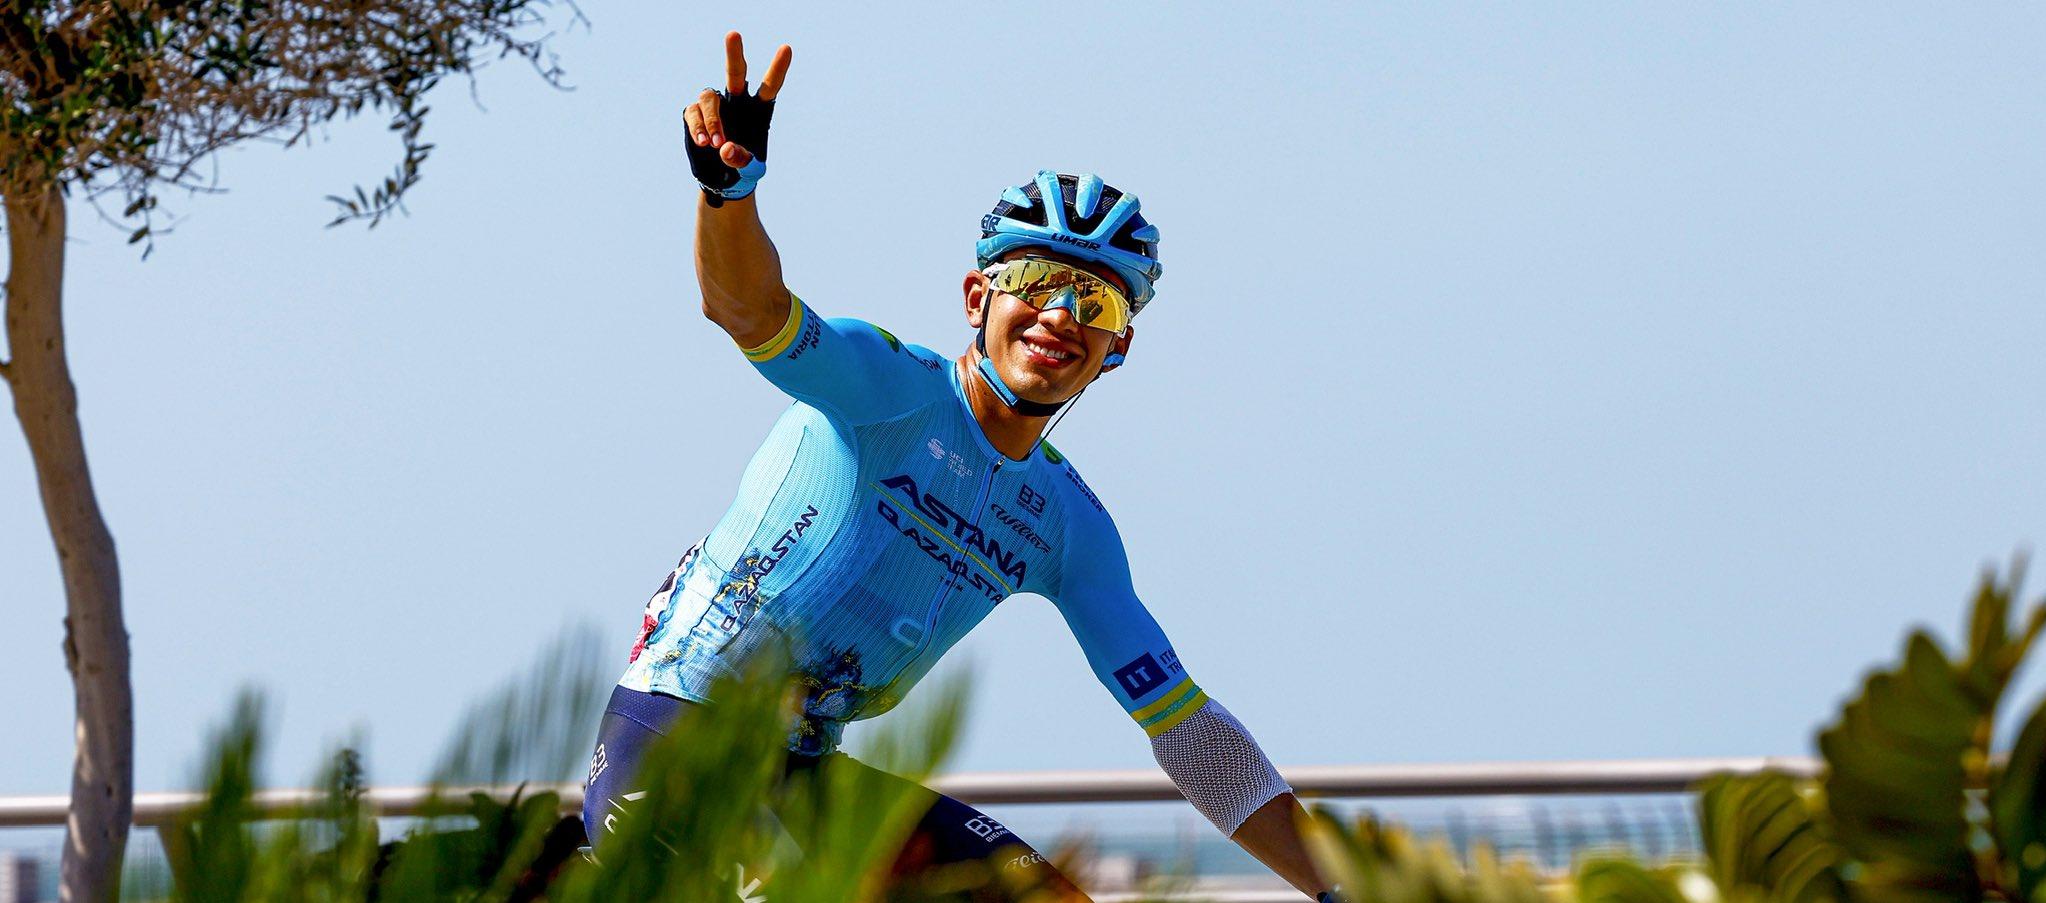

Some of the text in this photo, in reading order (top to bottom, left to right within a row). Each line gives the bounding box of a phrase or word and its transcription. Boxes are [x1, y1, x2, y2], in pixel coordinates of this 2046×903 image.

[1018, 483, 1046, 514] B3
[880, 474, 1027, 590] ASTANA
[720, 505, 819, 632] QAZAQSTAN
[1126, 666, 1152, 689] IT
[590, 743, 606, 778] B3
